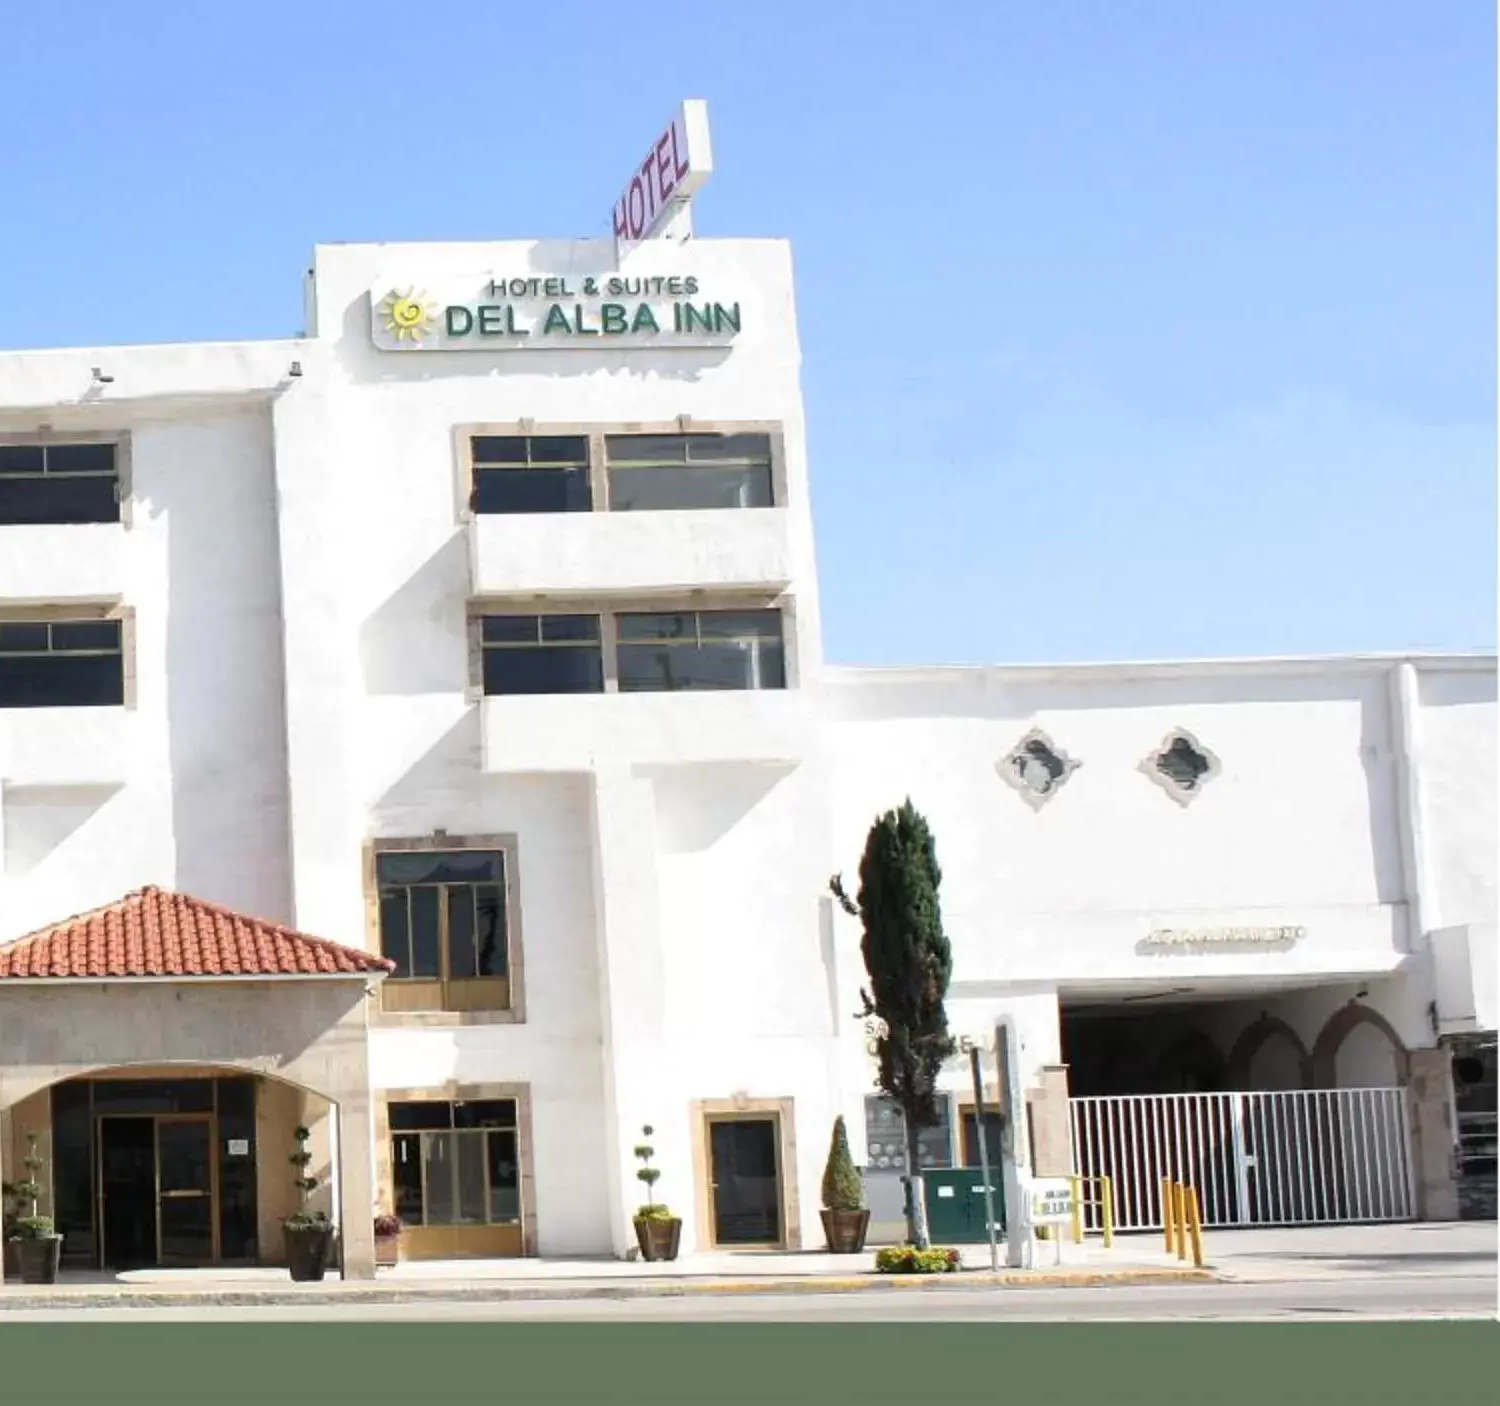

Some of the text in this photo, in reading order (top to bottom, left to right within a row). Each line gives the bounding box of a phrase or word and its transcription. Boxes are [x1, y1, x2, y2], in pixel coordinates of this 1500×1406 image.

[613, 121, 690, 240] HOTEL
[490, 276, 699, 297] HOTEL & SUITES
[445, 301, 741, 337] DEL ALBA INN
